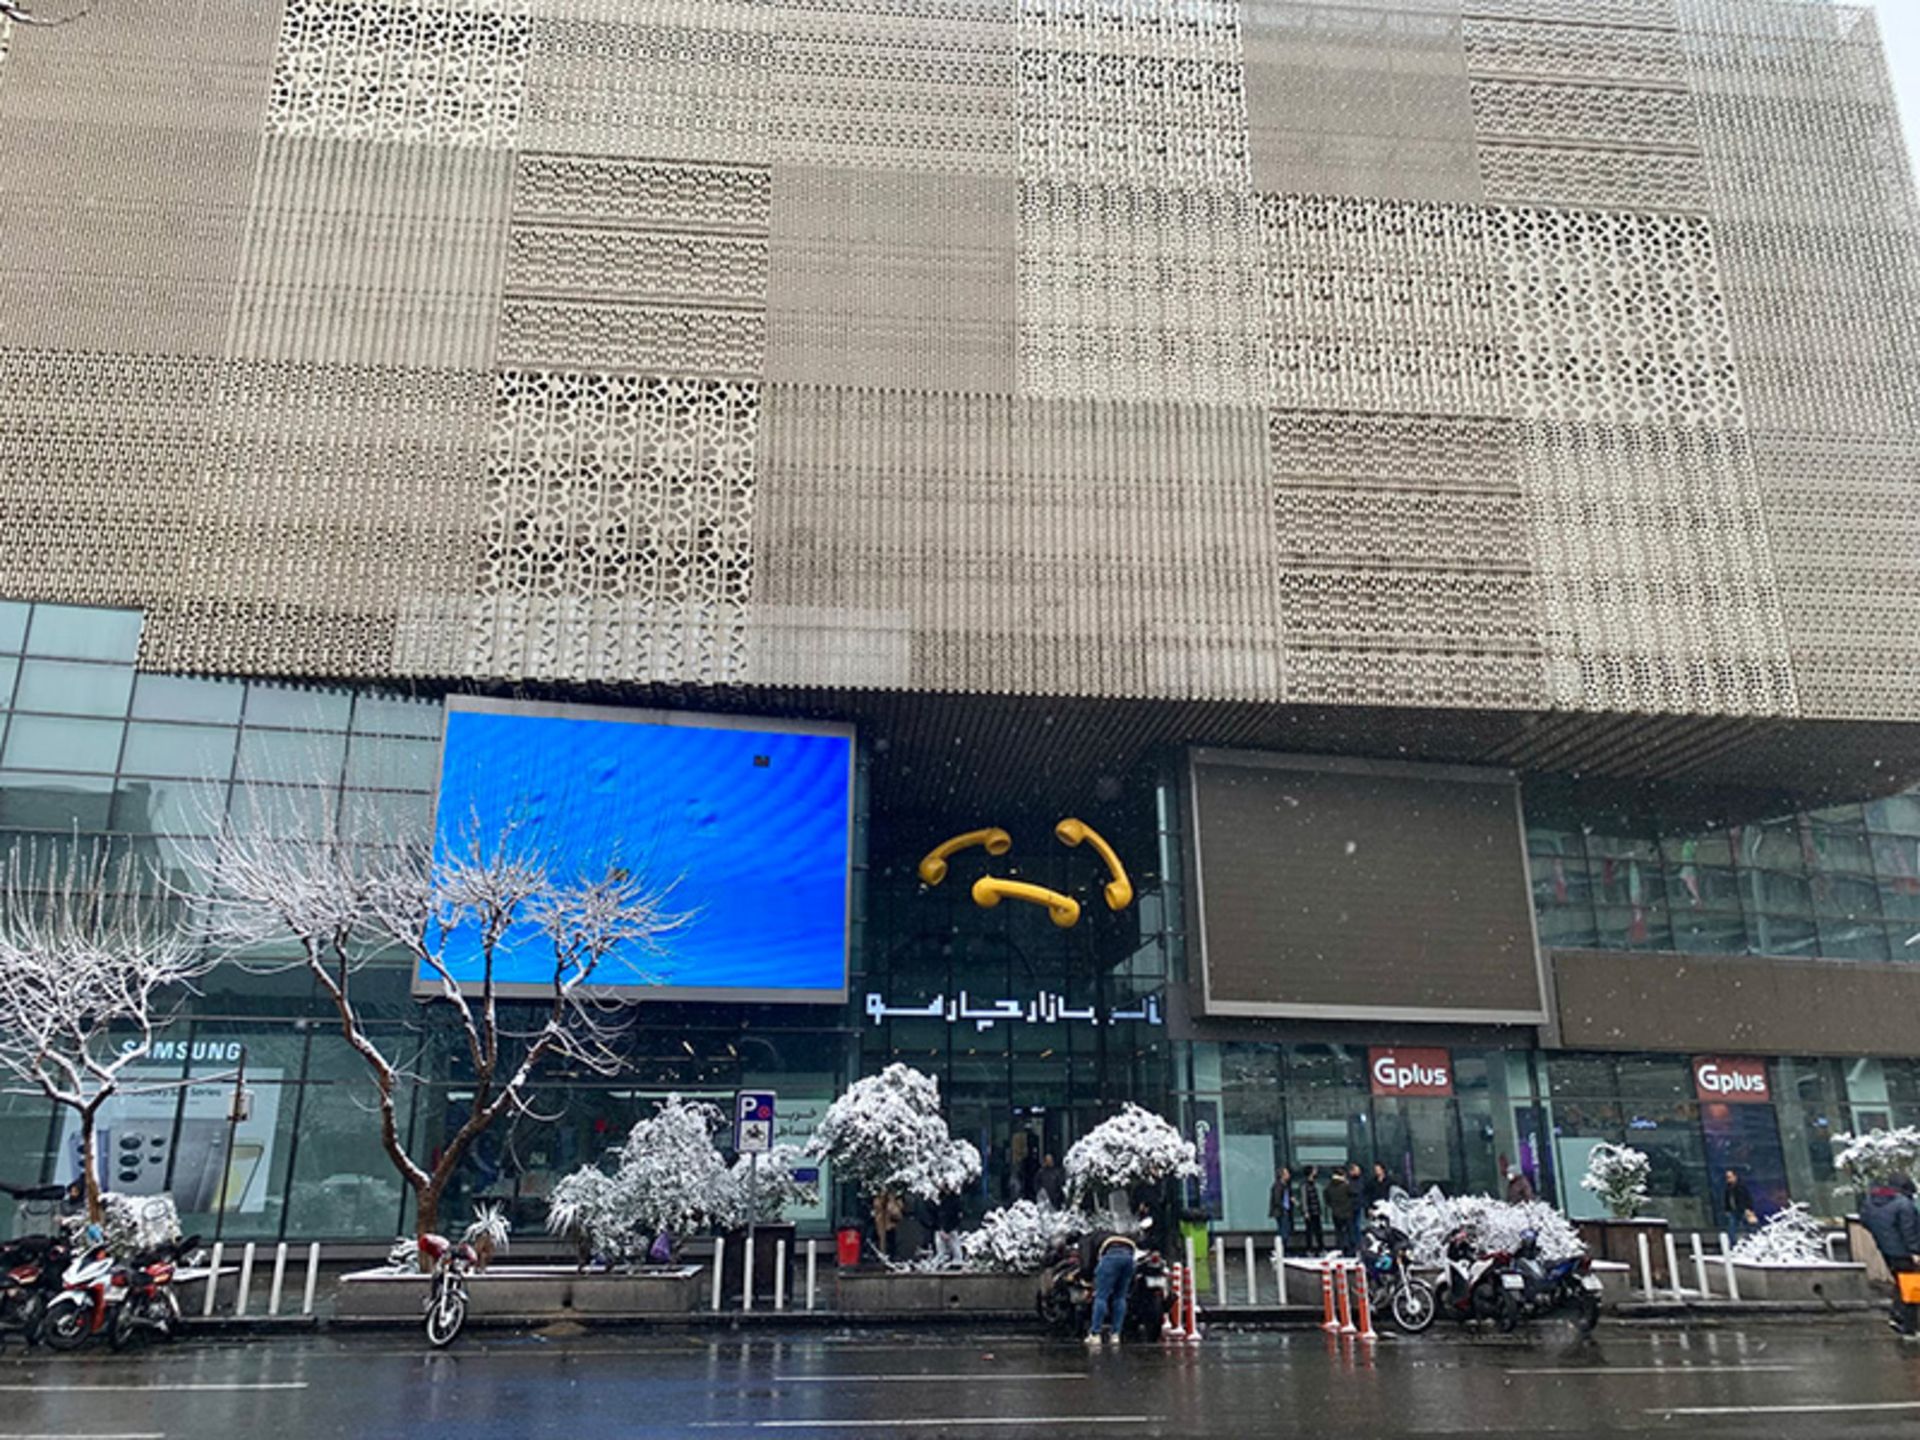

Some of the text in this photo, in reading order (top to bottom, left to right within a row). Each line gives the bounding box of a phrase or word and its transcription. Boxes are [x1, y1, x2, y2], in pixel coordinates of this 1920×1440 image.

[1374, 1057, 1448, 1089] Gplus
[1698, 1064, 1766, 1095] Gplus
[741, 1097, 757, 1119] P
